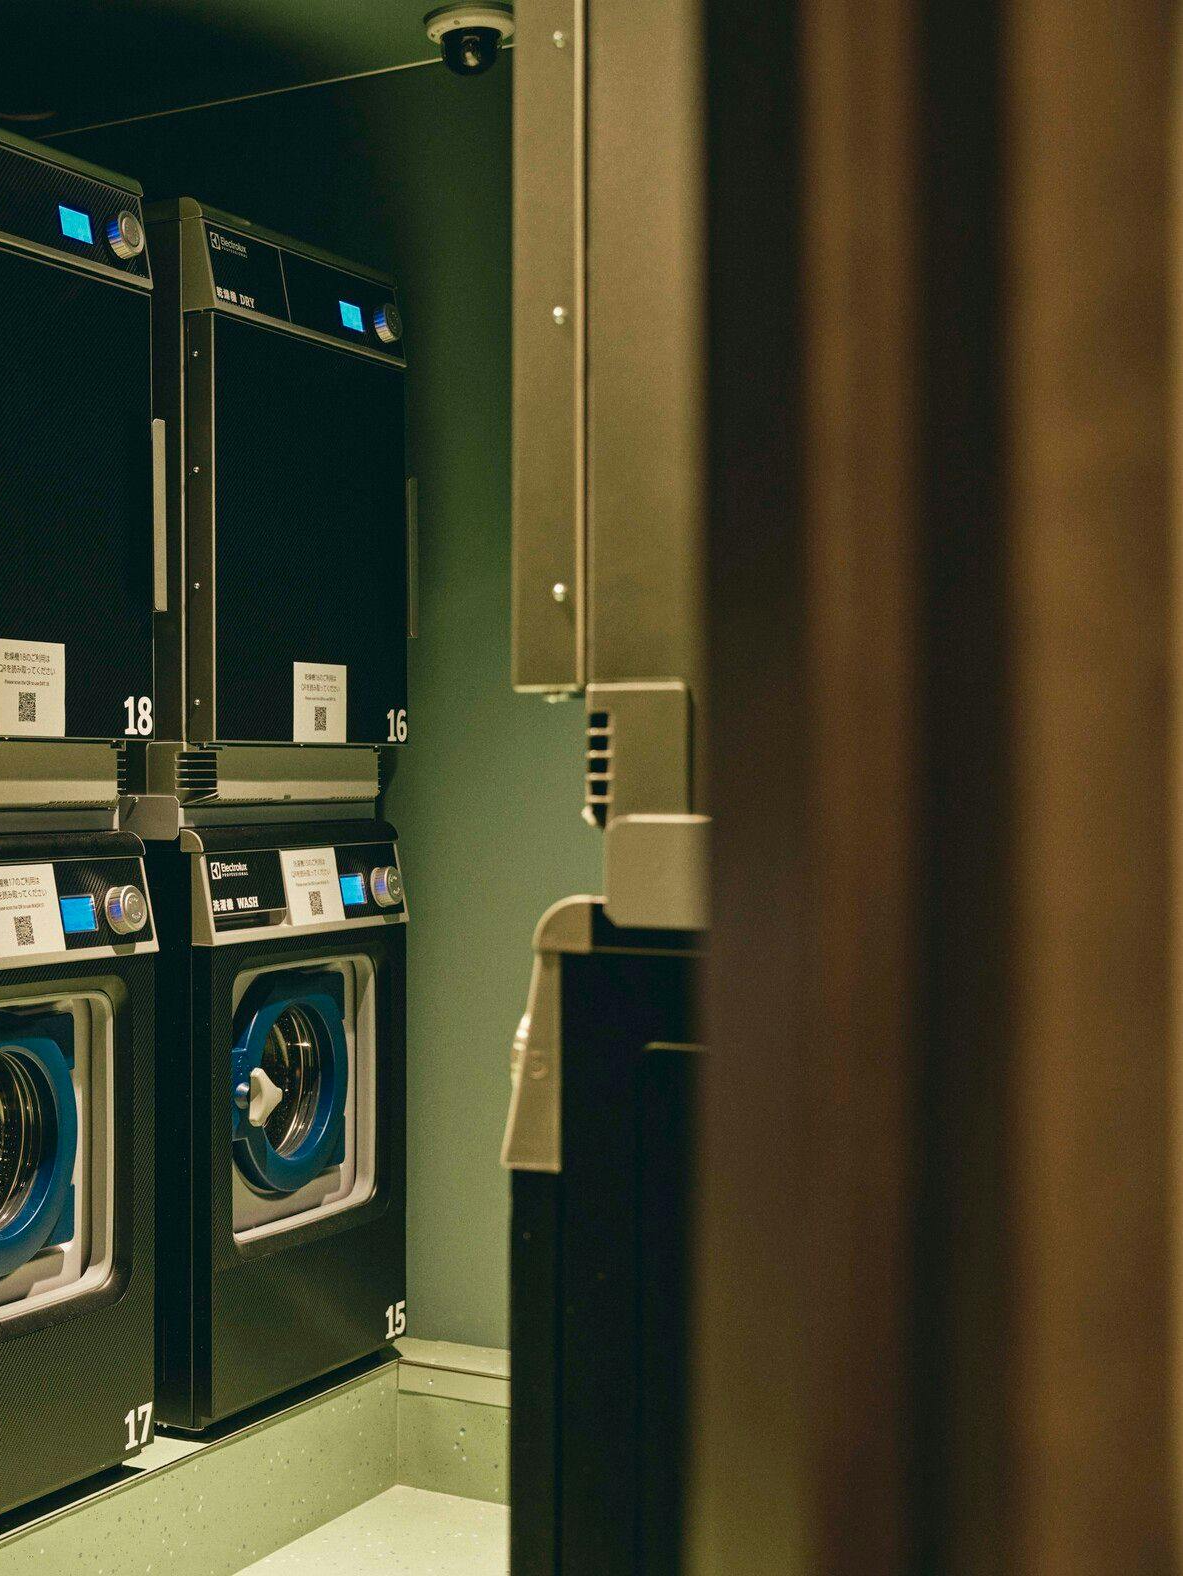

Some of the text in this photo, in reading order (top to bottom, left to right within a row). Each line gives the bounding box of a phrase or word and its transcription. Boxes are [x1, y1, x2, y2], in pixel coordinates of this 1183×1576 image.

[239, 294, 255, 308] DRY
[124, 696, 153, 736] 18
[387, 709, 408, 742] 16
[236, 896, 259, 909] WASH
[385, 1300, 406, 1339] 15
[124, 1401, 153, 1450] 17
